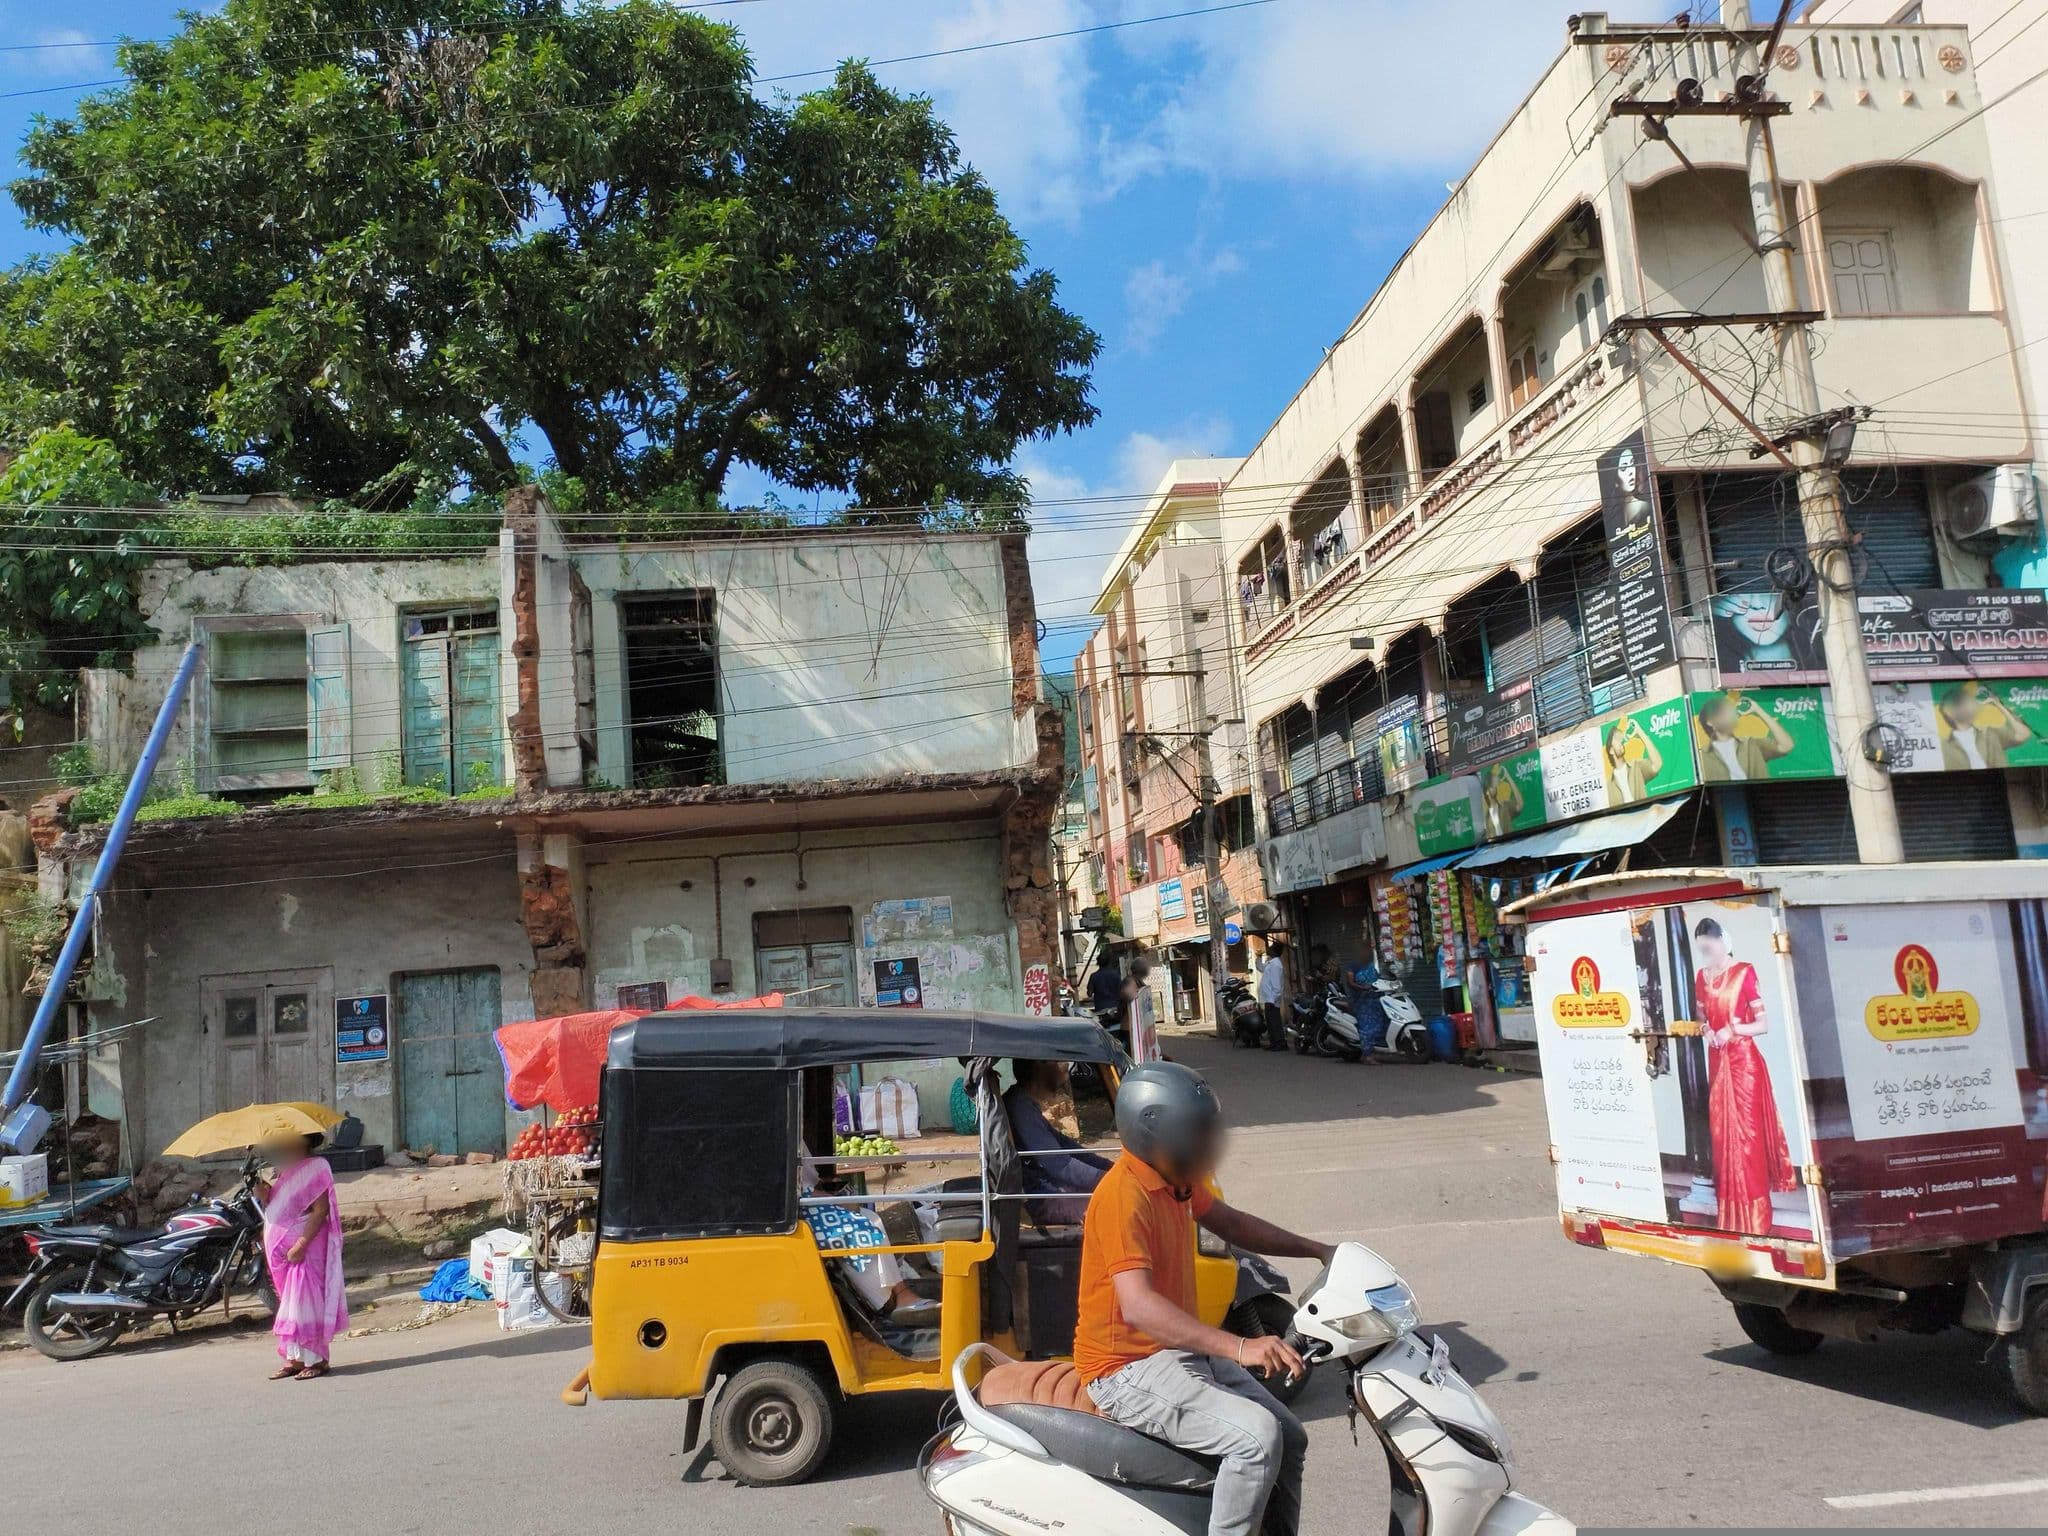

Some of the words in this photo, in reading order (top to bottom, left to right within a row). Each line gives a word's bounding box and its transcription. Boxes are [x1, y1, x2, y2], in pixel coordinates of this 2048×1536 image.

[1773, 696, 1818, 716] Sprite
[1650, 708, 1681, 733] Sprite
[1516, 757, 1538, 779] Sprite
[1569, 778, 1603, 797] GENERAL
[1562, 796, 1591, 814] STORES
[1559, 1000, 1584, 1018] కంచి
[1584, 998, 1624, 1024] కామాక్షి
[1876, 1002, 1913, 1026] కంచి
[1915, 998, 1971, 1031] కామాక్షి
[1903, 1074, 1942, 1095] పవిత్రత
[1944, 1067, 1992, 1095] పల్లవించే
[630, 1259, 652, 1269] AP31
[653, 1257, 666, 1267] TB
[668, 1255, 689, 1266] 9034
